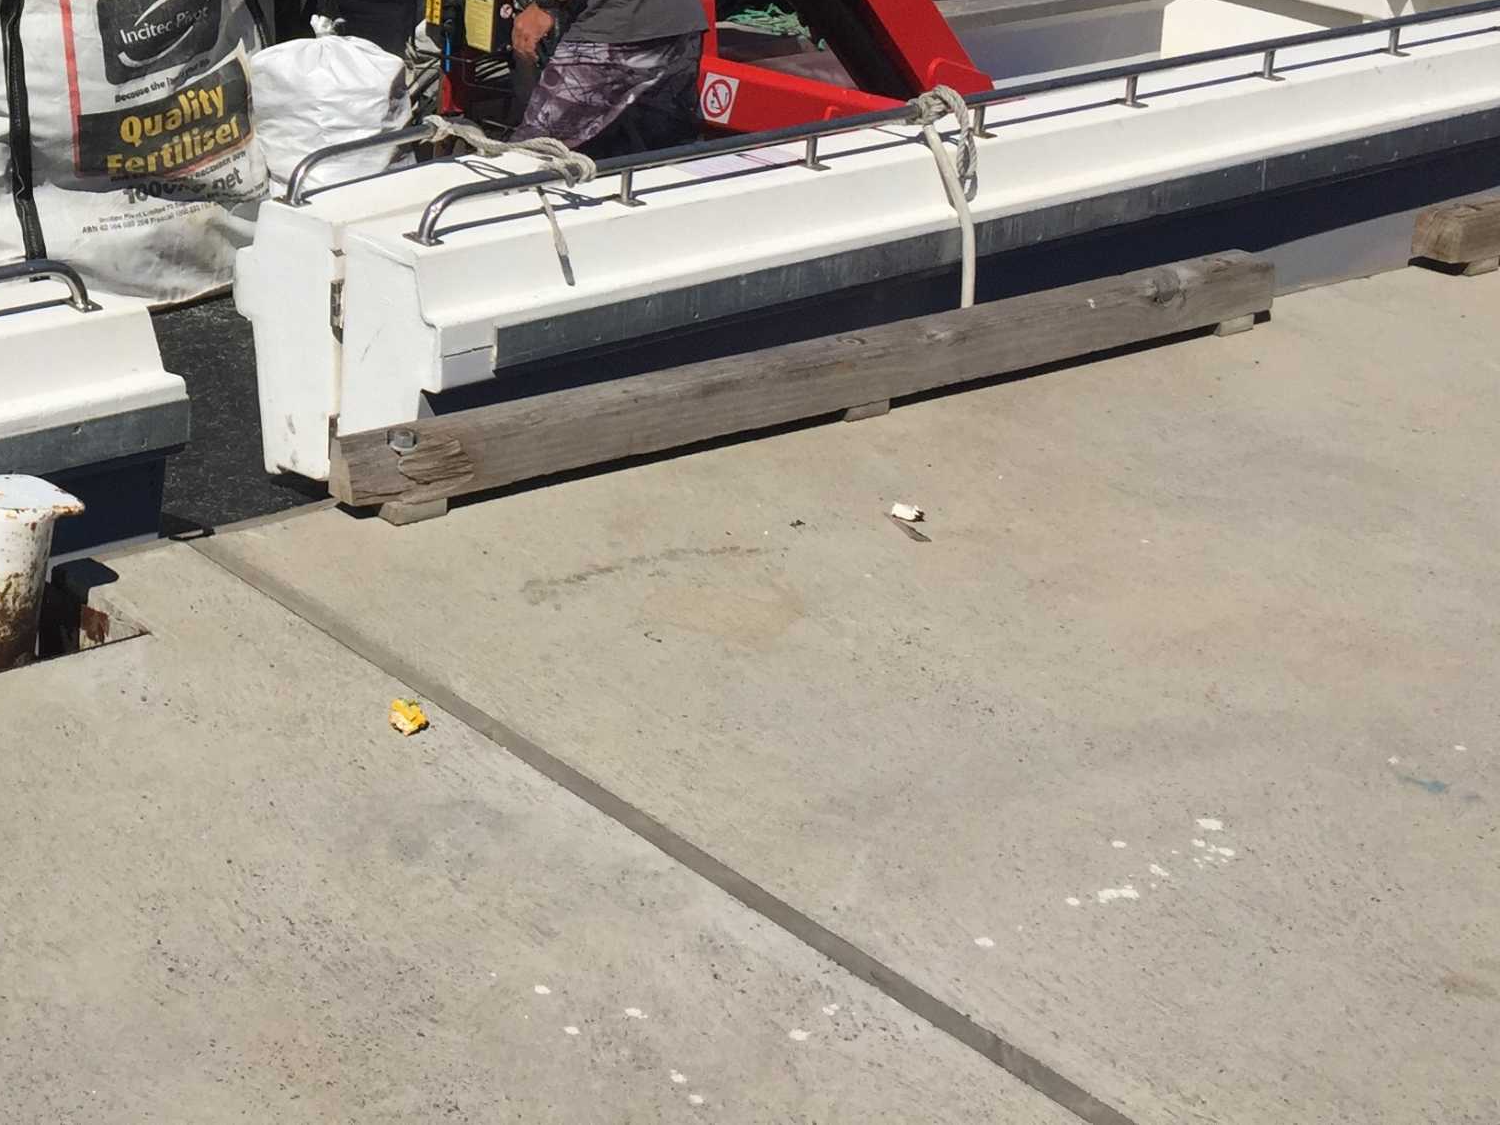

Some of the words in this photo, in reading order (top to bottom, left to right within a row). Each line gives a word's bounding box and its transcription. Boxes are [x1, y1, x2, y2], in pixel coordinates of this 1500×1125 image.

[120, 20, 173, 45] Incitec
[120, 85, 224, 147] Quality
[212, 167, 244, 190] net
